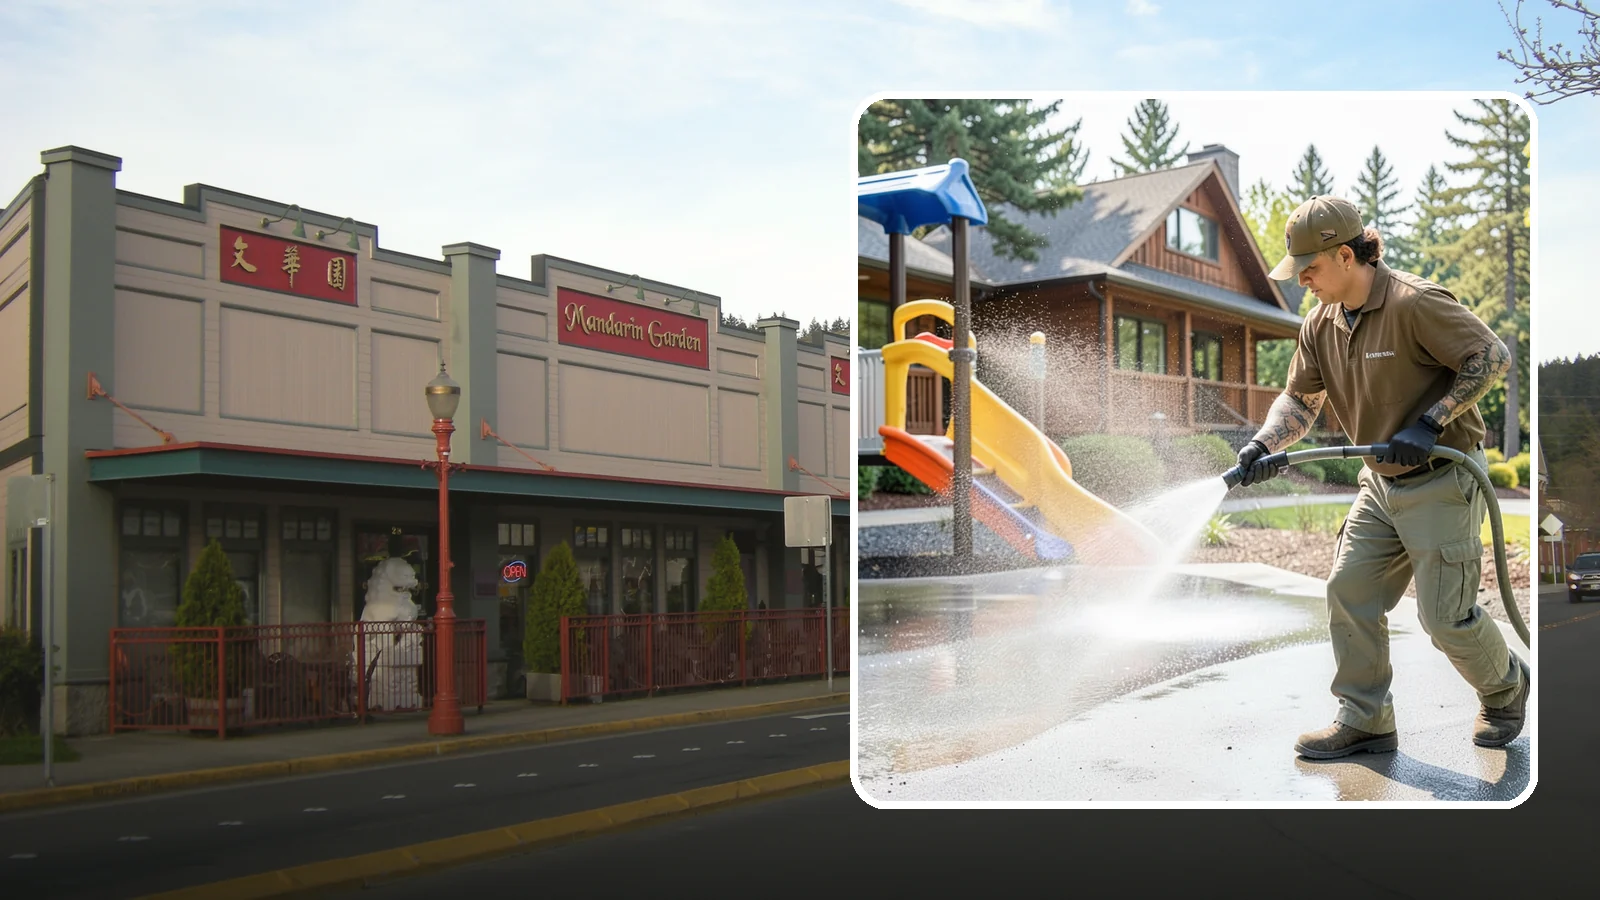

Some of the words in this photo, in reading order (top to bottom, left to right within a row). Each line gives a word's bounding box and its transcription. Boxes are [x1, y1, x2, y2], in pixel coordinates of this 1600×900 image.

[230, 235, 346, 291] 文華園
[564, 302, 644, 341] Mandarin
[648, 320, 701, 352] Garden
[503, 565, 527, 578] OPEN
